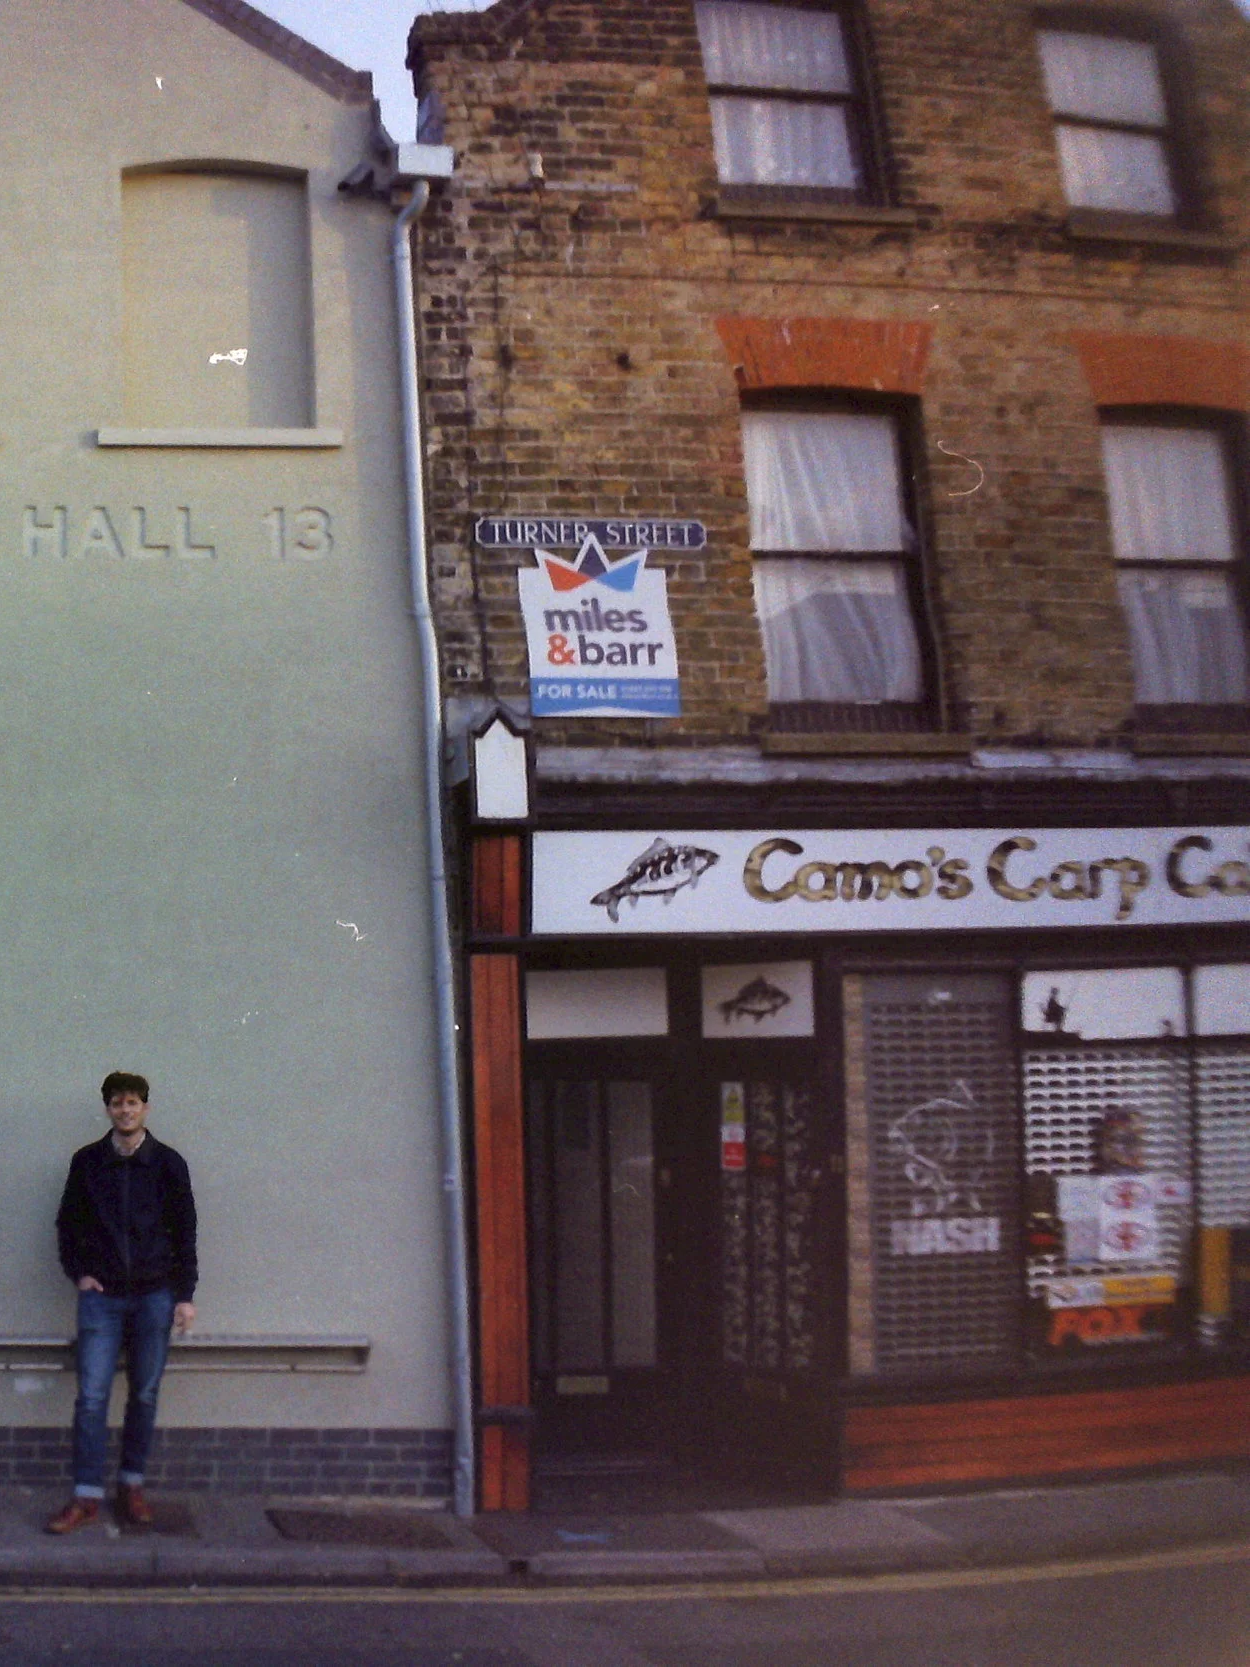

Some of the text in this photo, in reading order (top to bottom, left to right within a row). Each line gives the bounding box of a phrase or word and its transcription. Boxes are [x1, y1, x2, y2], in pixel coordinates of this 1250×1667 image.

[22, 504, 217, 559] HALL
[262, 505, 335, 560] 13
[489, 521, 693, 546] TURNER STREET
[543, 597, 649, 633] miles
[537, 683, 572, 699] FOR
[576, 683, 617, 699] SALE
[742, 834, 1250, 921] Camo's Carp Ca
[891, 1216, 1000, 1256] NASH
